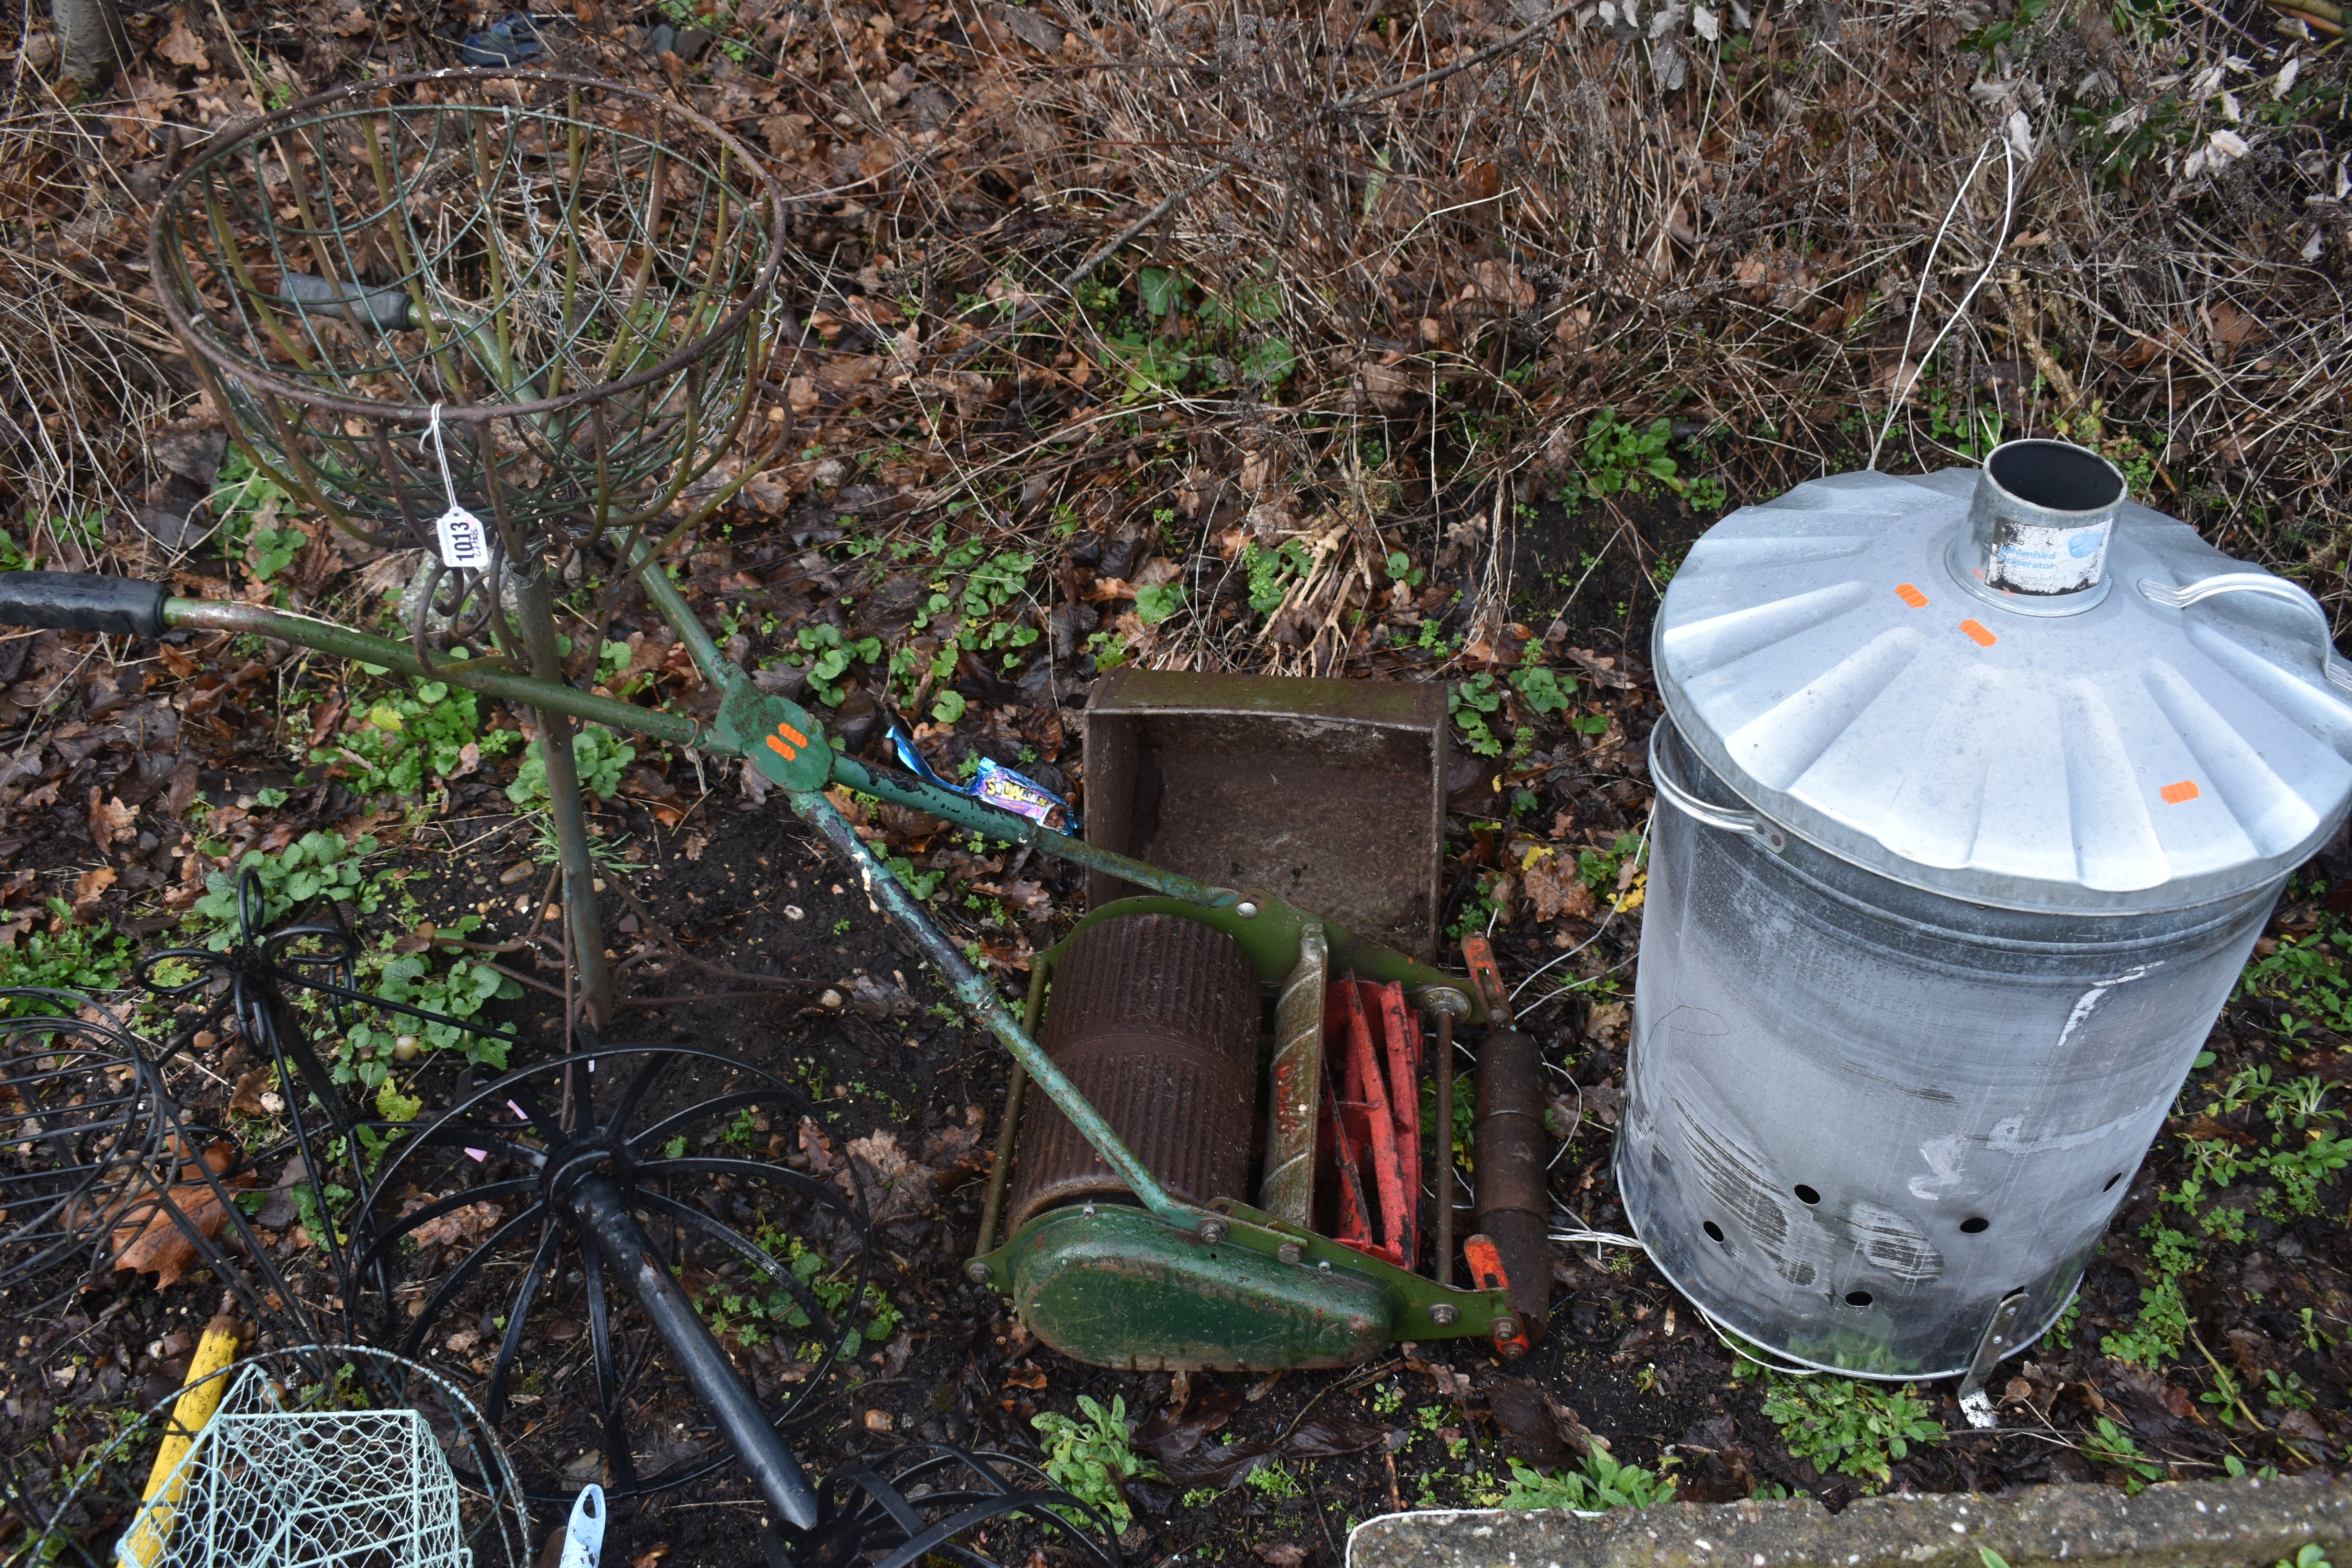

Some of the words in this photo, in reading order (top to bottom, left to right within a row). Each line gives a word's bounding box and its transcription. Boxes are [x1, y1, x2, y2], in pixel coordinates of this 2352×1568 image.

[450, 522, 475, 561] 1013
[2000, 546, 2056, 559] lvanised
[1999, 555, 2055, 569] nerator
[985, 777, 1048, 808] SQUARES
